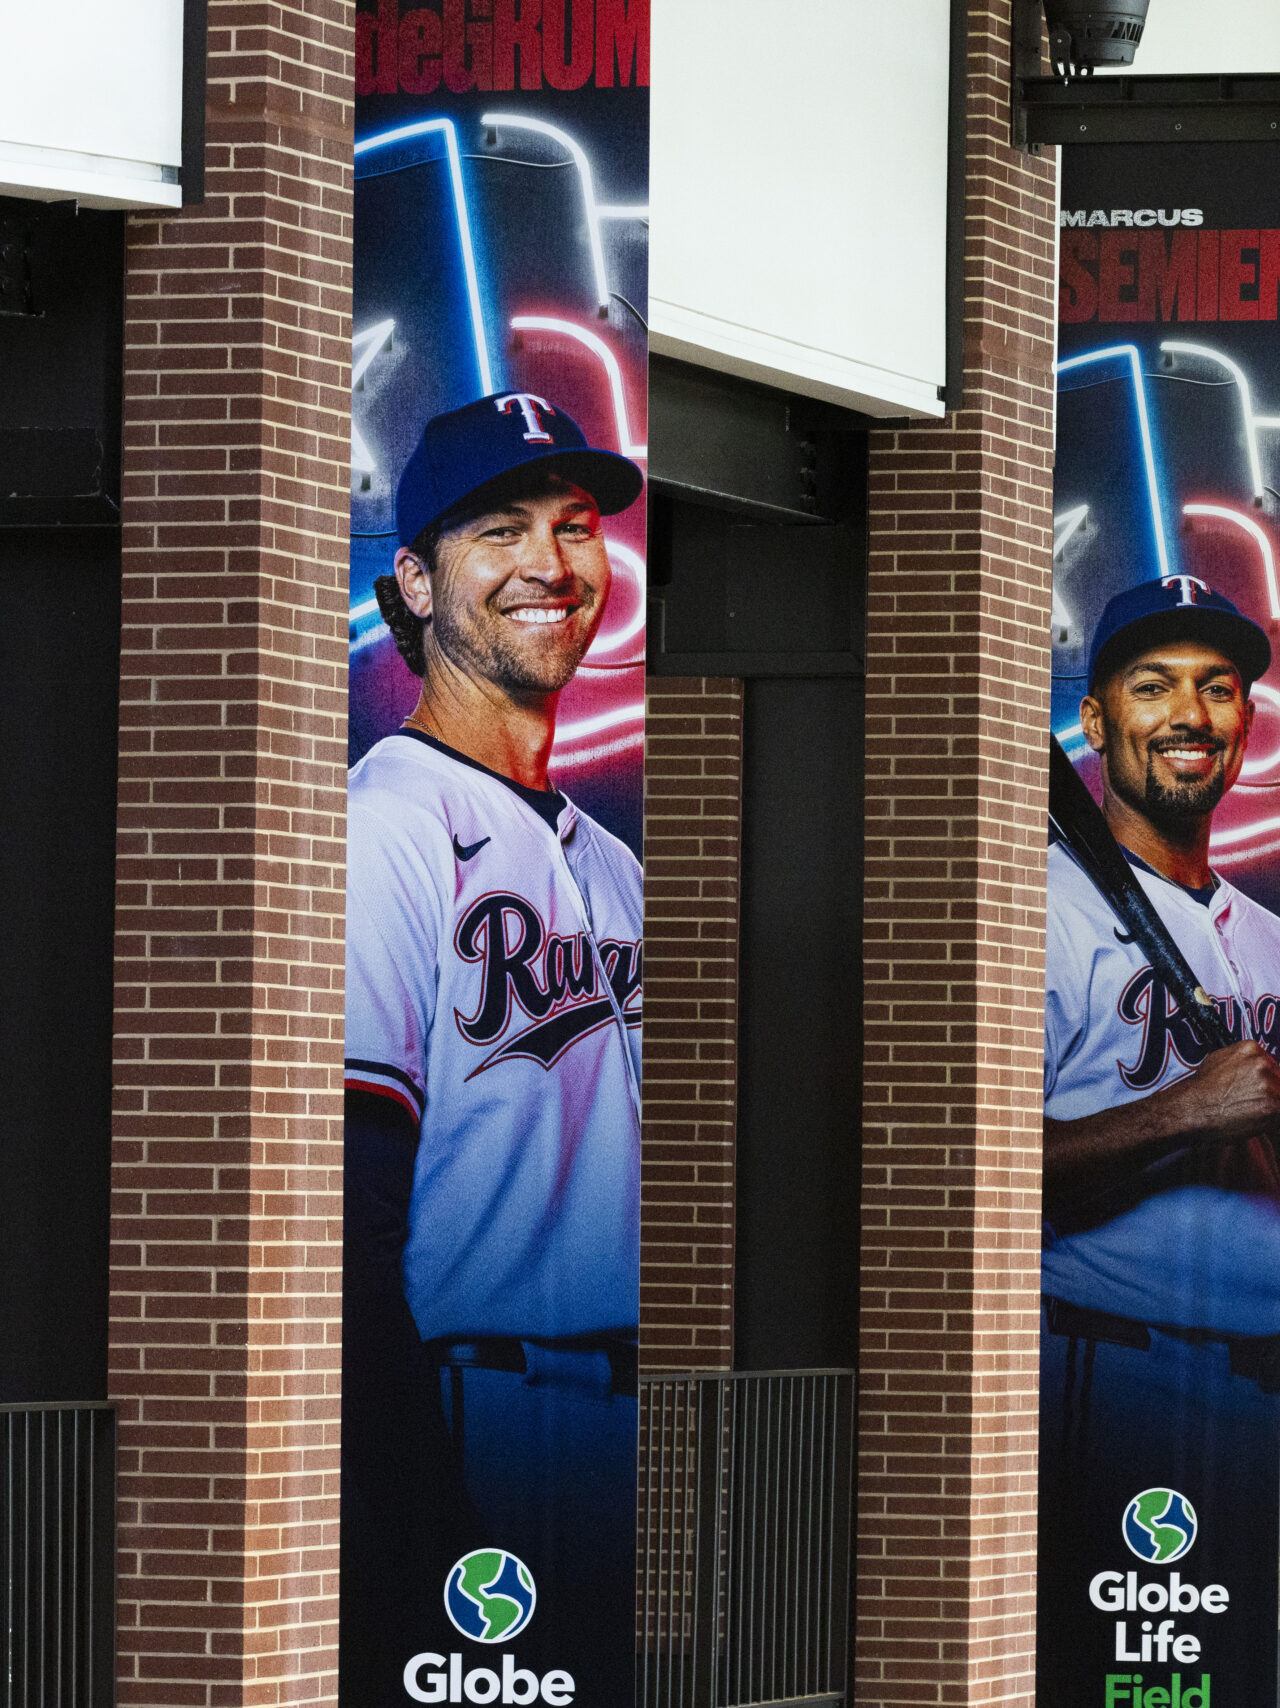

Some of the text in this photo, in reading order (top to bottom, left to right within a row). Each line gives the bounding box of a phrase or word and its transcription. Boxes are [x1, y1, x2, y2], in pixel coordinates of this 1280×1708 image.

[355, 0, 649, 95] deGROM
[1060, 209, 1204, 227] MARCUS
[494, 393, 556, 444] T
[1161, 574, 1211, 607] T
[454, 890, 642, 1046] Rang
[1089, 1571, 1230, 1614] Globe
[1115, 1620, 1201, 1663] Life
[403, 1652, 576, 1706] Globe
[1105, 1673, 1211, 1708] Field
